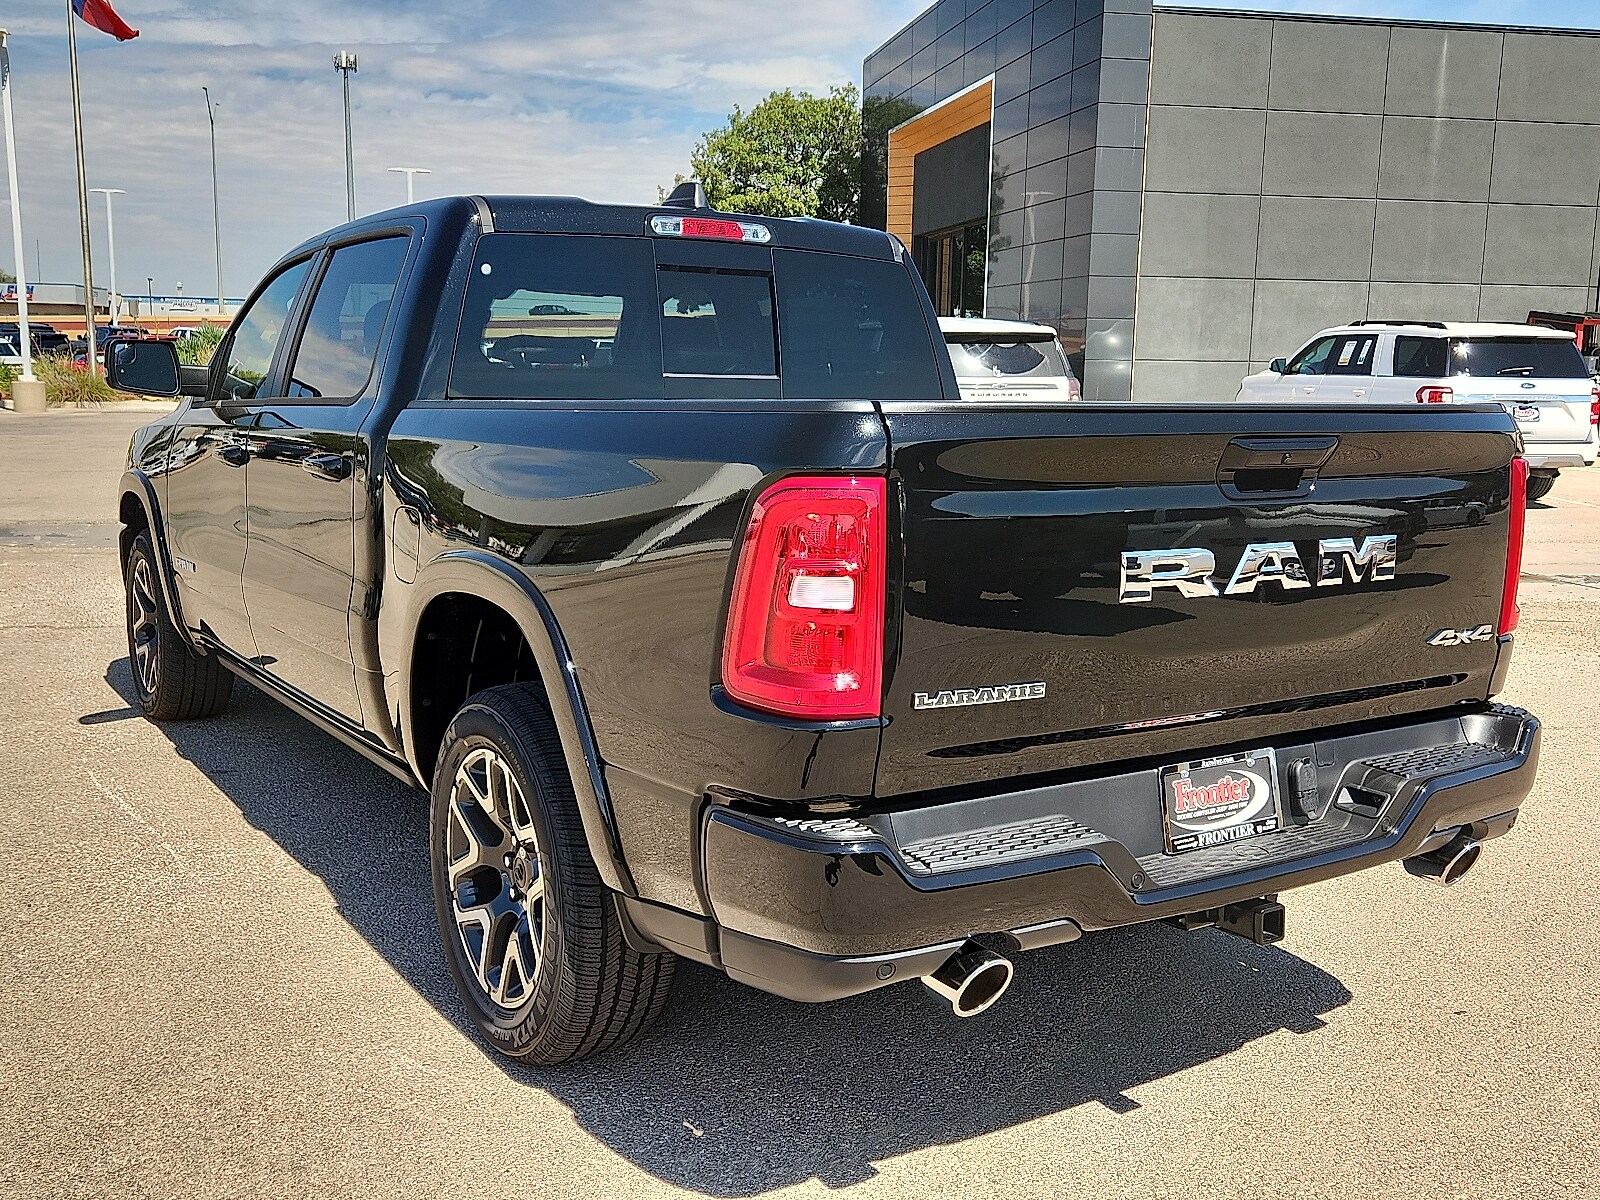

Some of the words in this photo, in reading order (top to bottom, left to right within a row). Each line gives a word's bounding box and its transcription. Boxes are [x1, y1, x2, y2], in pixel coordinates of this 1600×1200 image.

[1119, 534, 1398, 604] RAM
[912, 681, 1047, 710] LARAMIE
[1172, 776, 1250, 812] Frontier
[1197, 824, 1256, 847] FRONTIER
